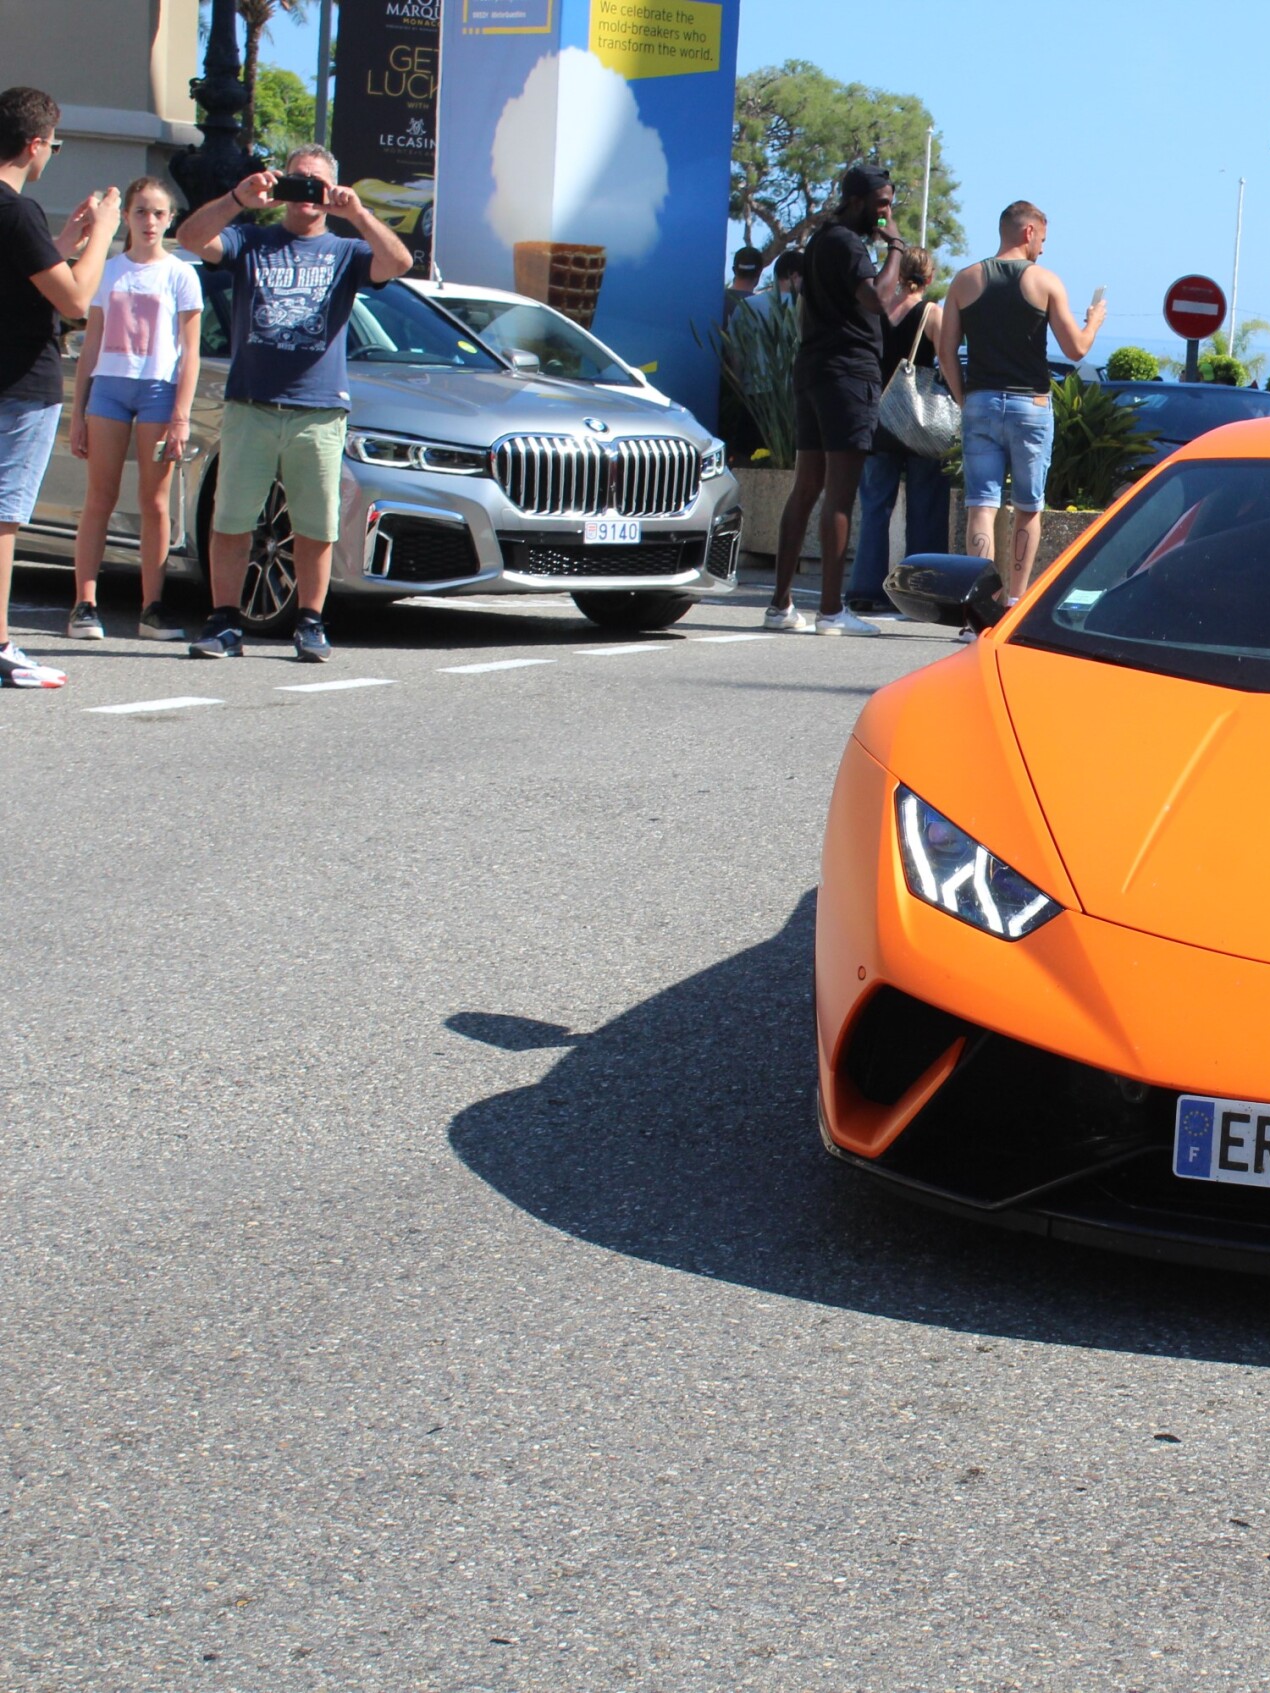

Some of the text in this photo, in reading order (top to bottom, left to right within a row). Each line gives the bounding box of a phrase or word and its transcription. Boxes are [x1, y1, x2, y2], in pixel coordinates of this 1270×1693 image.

[600, 1, 694, 24] We celebrate the
[598, 20, 706, 43] mold-breakers who
[598, 36, 713, 61] transform the world.
[407, 101, 429, 109] WITH
[380, 134, 394, 146] LE
[599, 523, 638, 540] 9140
[1188, 1146, 1201, 1163] F
